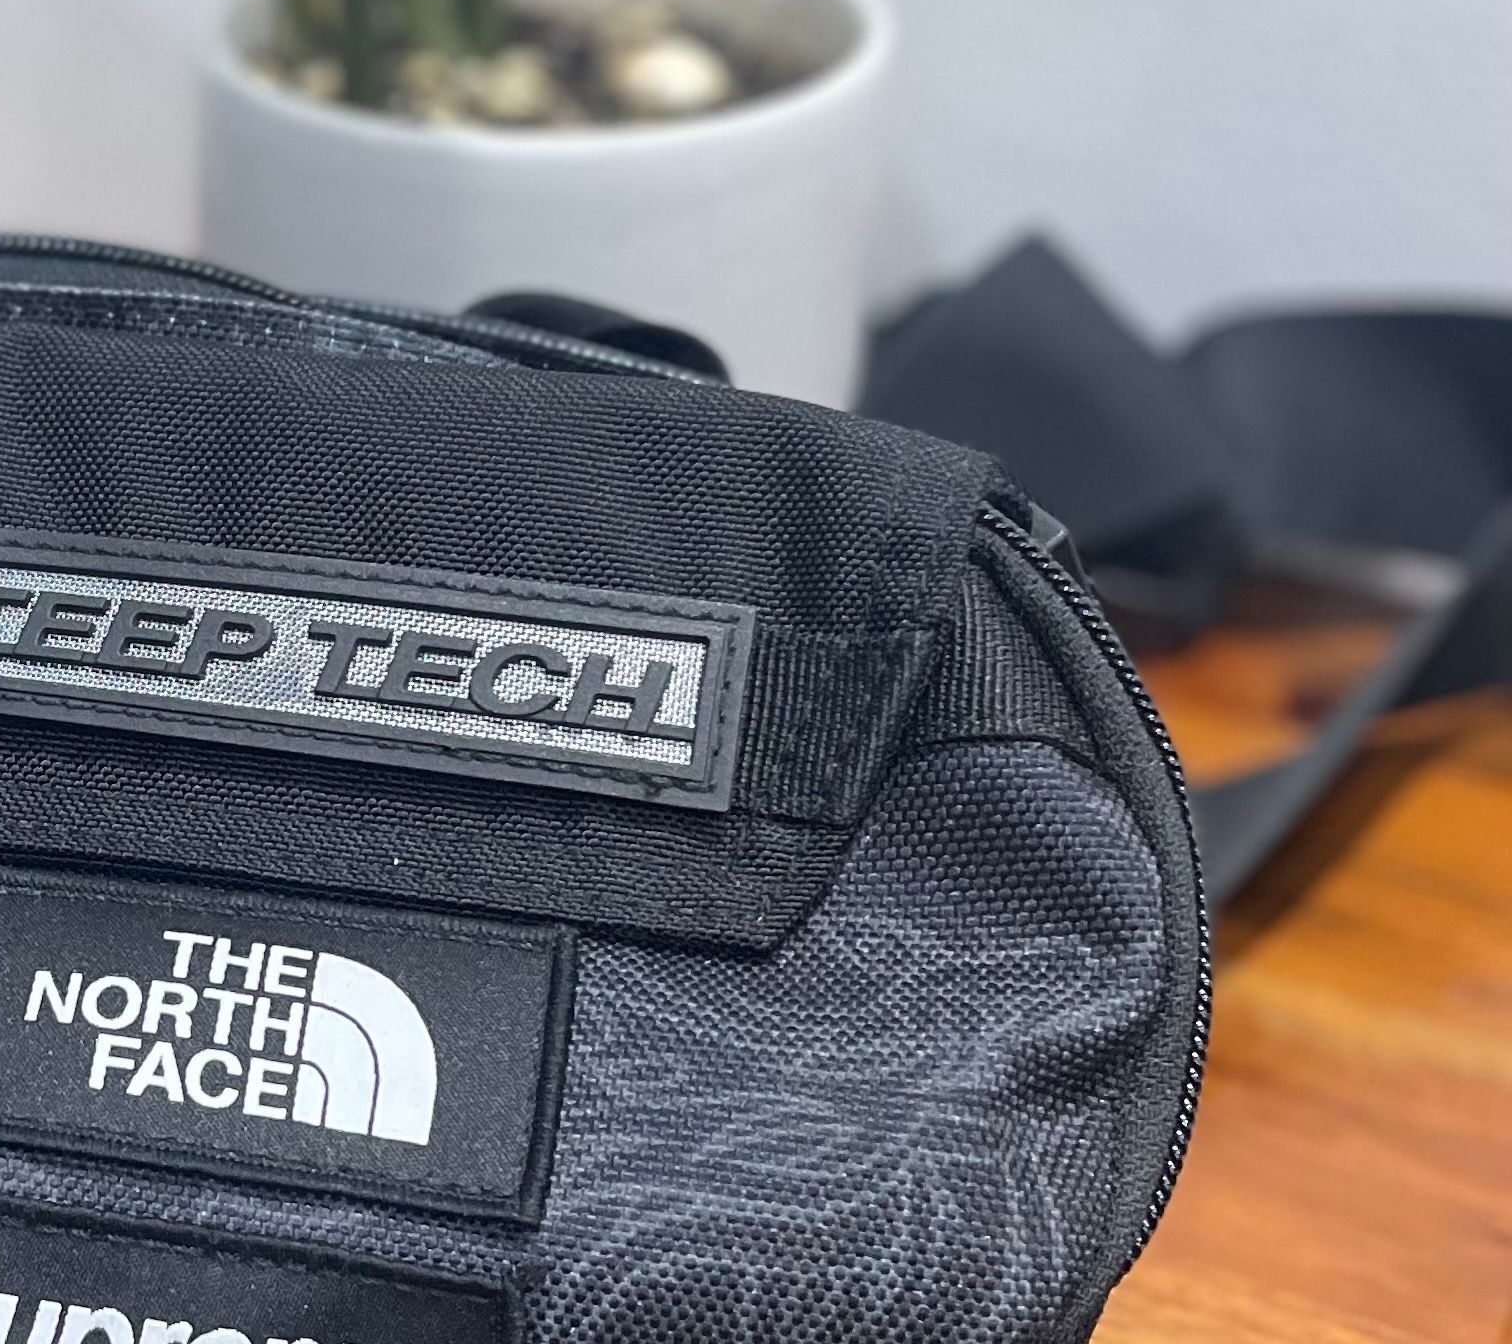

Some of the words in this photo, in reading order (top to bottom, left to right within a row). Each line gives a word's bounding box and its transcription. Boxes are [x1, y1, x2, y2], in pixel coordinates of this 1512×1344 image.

[308, 620, 675, 734] TECH
[163, 930, 314, 998] THE
[23, 970, 305, 1057] NORTH
[88, 1032, 294, 1120] FACE
